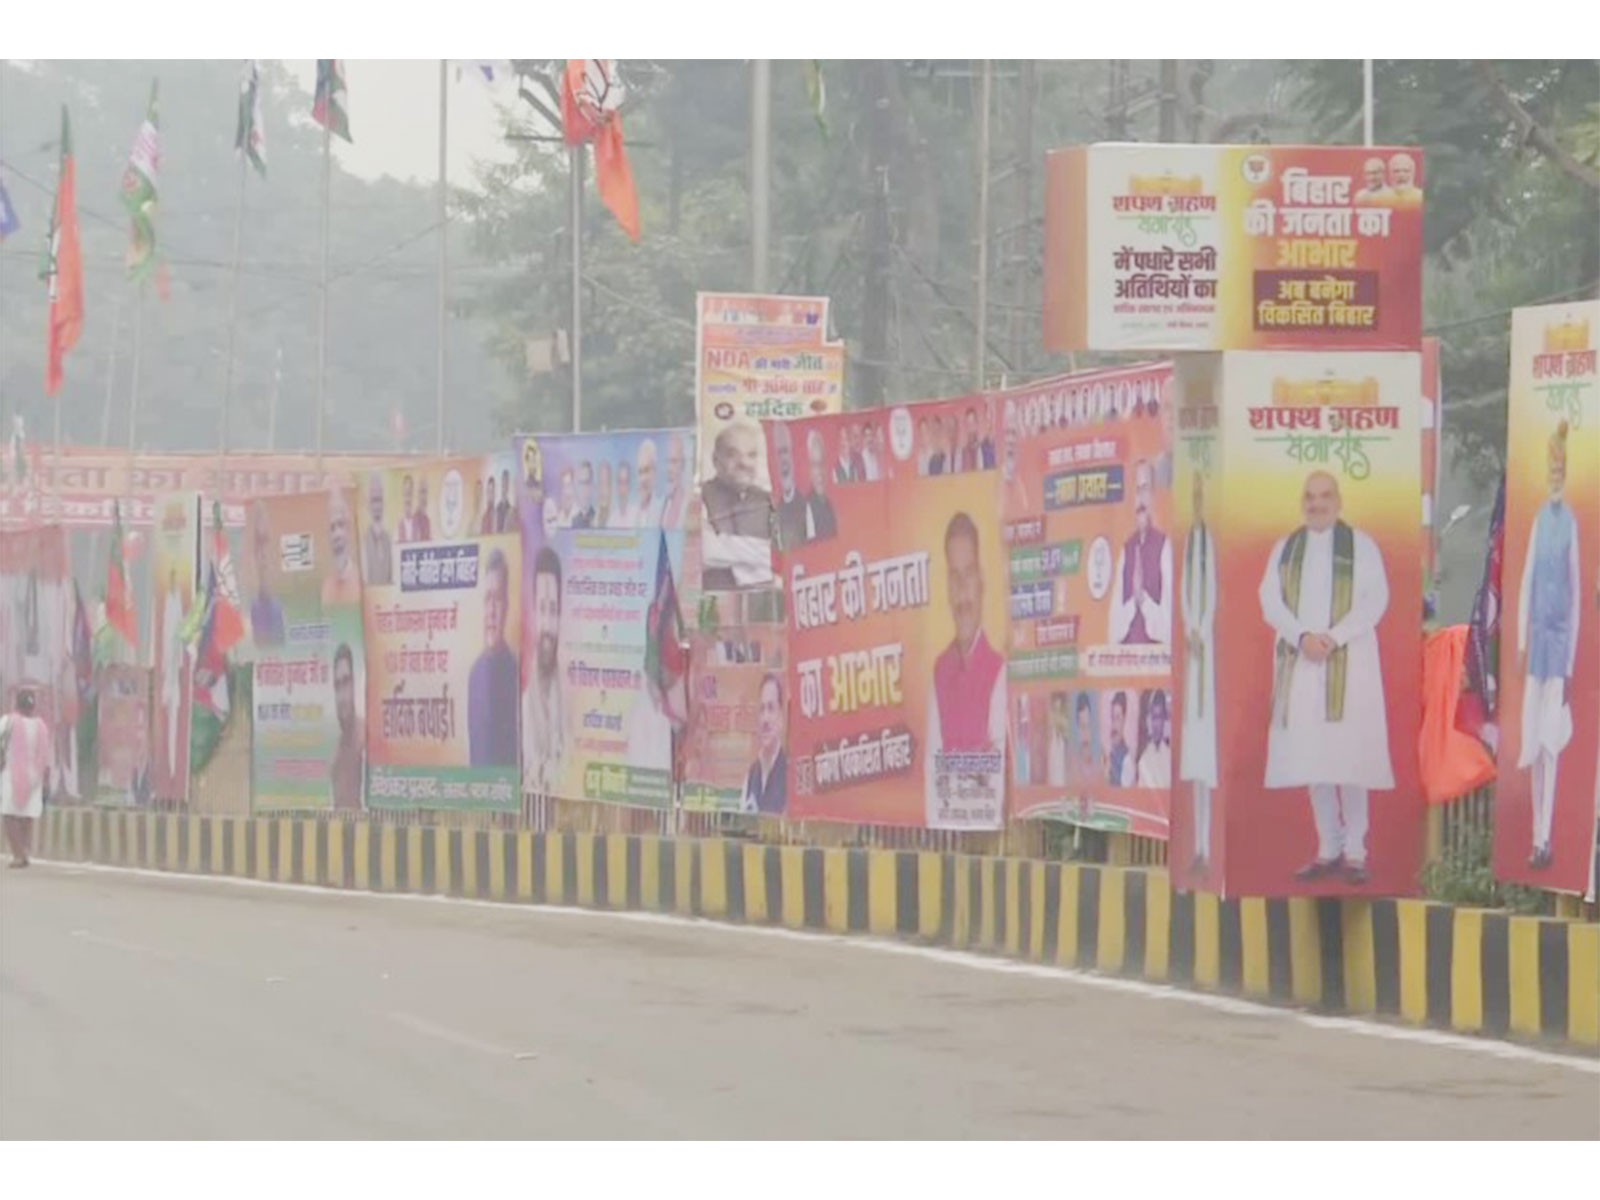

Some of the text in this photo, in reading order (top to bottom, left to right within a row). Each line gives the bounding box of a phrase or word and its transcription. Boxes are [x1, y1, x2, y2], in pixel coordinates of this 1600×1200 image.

[1282, 168, 1351, 205] बिहार
[1112, 195, 1163, 212] शपथ
[1243, 200, 1392, 237] की जनता का
[1112, 245, 1135, 271] में
[1176, 245, 1218, 271] सभी
[1277, 238, 1357, 268] आभार
[1113, 273, 1218, 299] अतिथियों का
[1278, 275, 1356, 300] अब बनेगा
[1257, 298, 1377, 326] विकसित बिहार
[1248, 405, 1399, 432] शपथ ग्रहण
[791, 549, 930, 630] बिहार की जनता
[796, 656, 825, 719] का
[826, 641, 903, 713] आभार
[382, 680, 414, 739] हार्दिक
